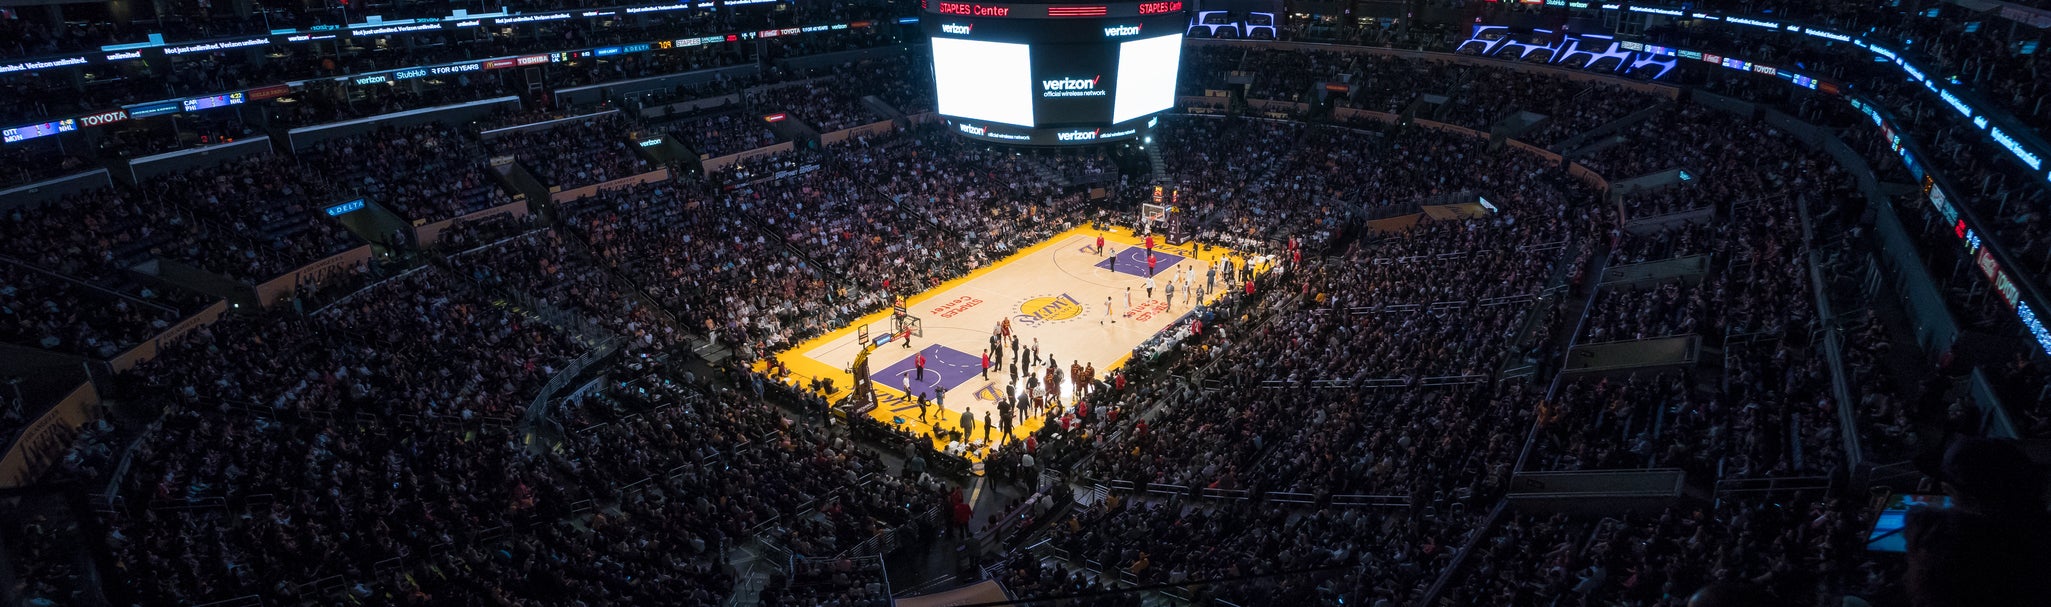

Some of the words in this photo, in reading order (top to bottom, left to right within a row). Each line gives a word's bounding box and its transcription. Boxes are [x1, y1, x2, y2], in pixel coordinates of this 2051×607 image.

[939, 2, 971, 15] STAPLES
[973, 5, 1009, 16] Center
[1139, 1, 1169, 14] STAPLES
[941, 23, 970, 34] verizon
[1104, 25, 1139, 36] verizon
[190, 43, 220, 51] unlimited.
[242, 38, 270, 46] unlimited.
[676, 38, 701, 47] STAPLES
[107, 51, 141, 60] unlimited
[518, 55, 549, 64] TOSHIBA
[26, 62, 53, 70] Verizon
[53, 57, 88, 66] unlimited.
[396, 70, 427, 79] StubHub
[1754, 65, 1776, 75] TOYOTA
[356, 75, 386, 84] verizon
[1042, 77, 1094, 90] verizon
[81, 111, 127, 127] TOYOTA
[960, 123, 984, 136] verizon
[1057, 130, 1095, 140] verizon
[4, 134, 23, 143] MON
[640, 139, 661, 147] verizon
[336, 201, 365, 213] DELTA
[930, 295, 971, 314] Center
[940, 298, 983, 318] STAPLES
